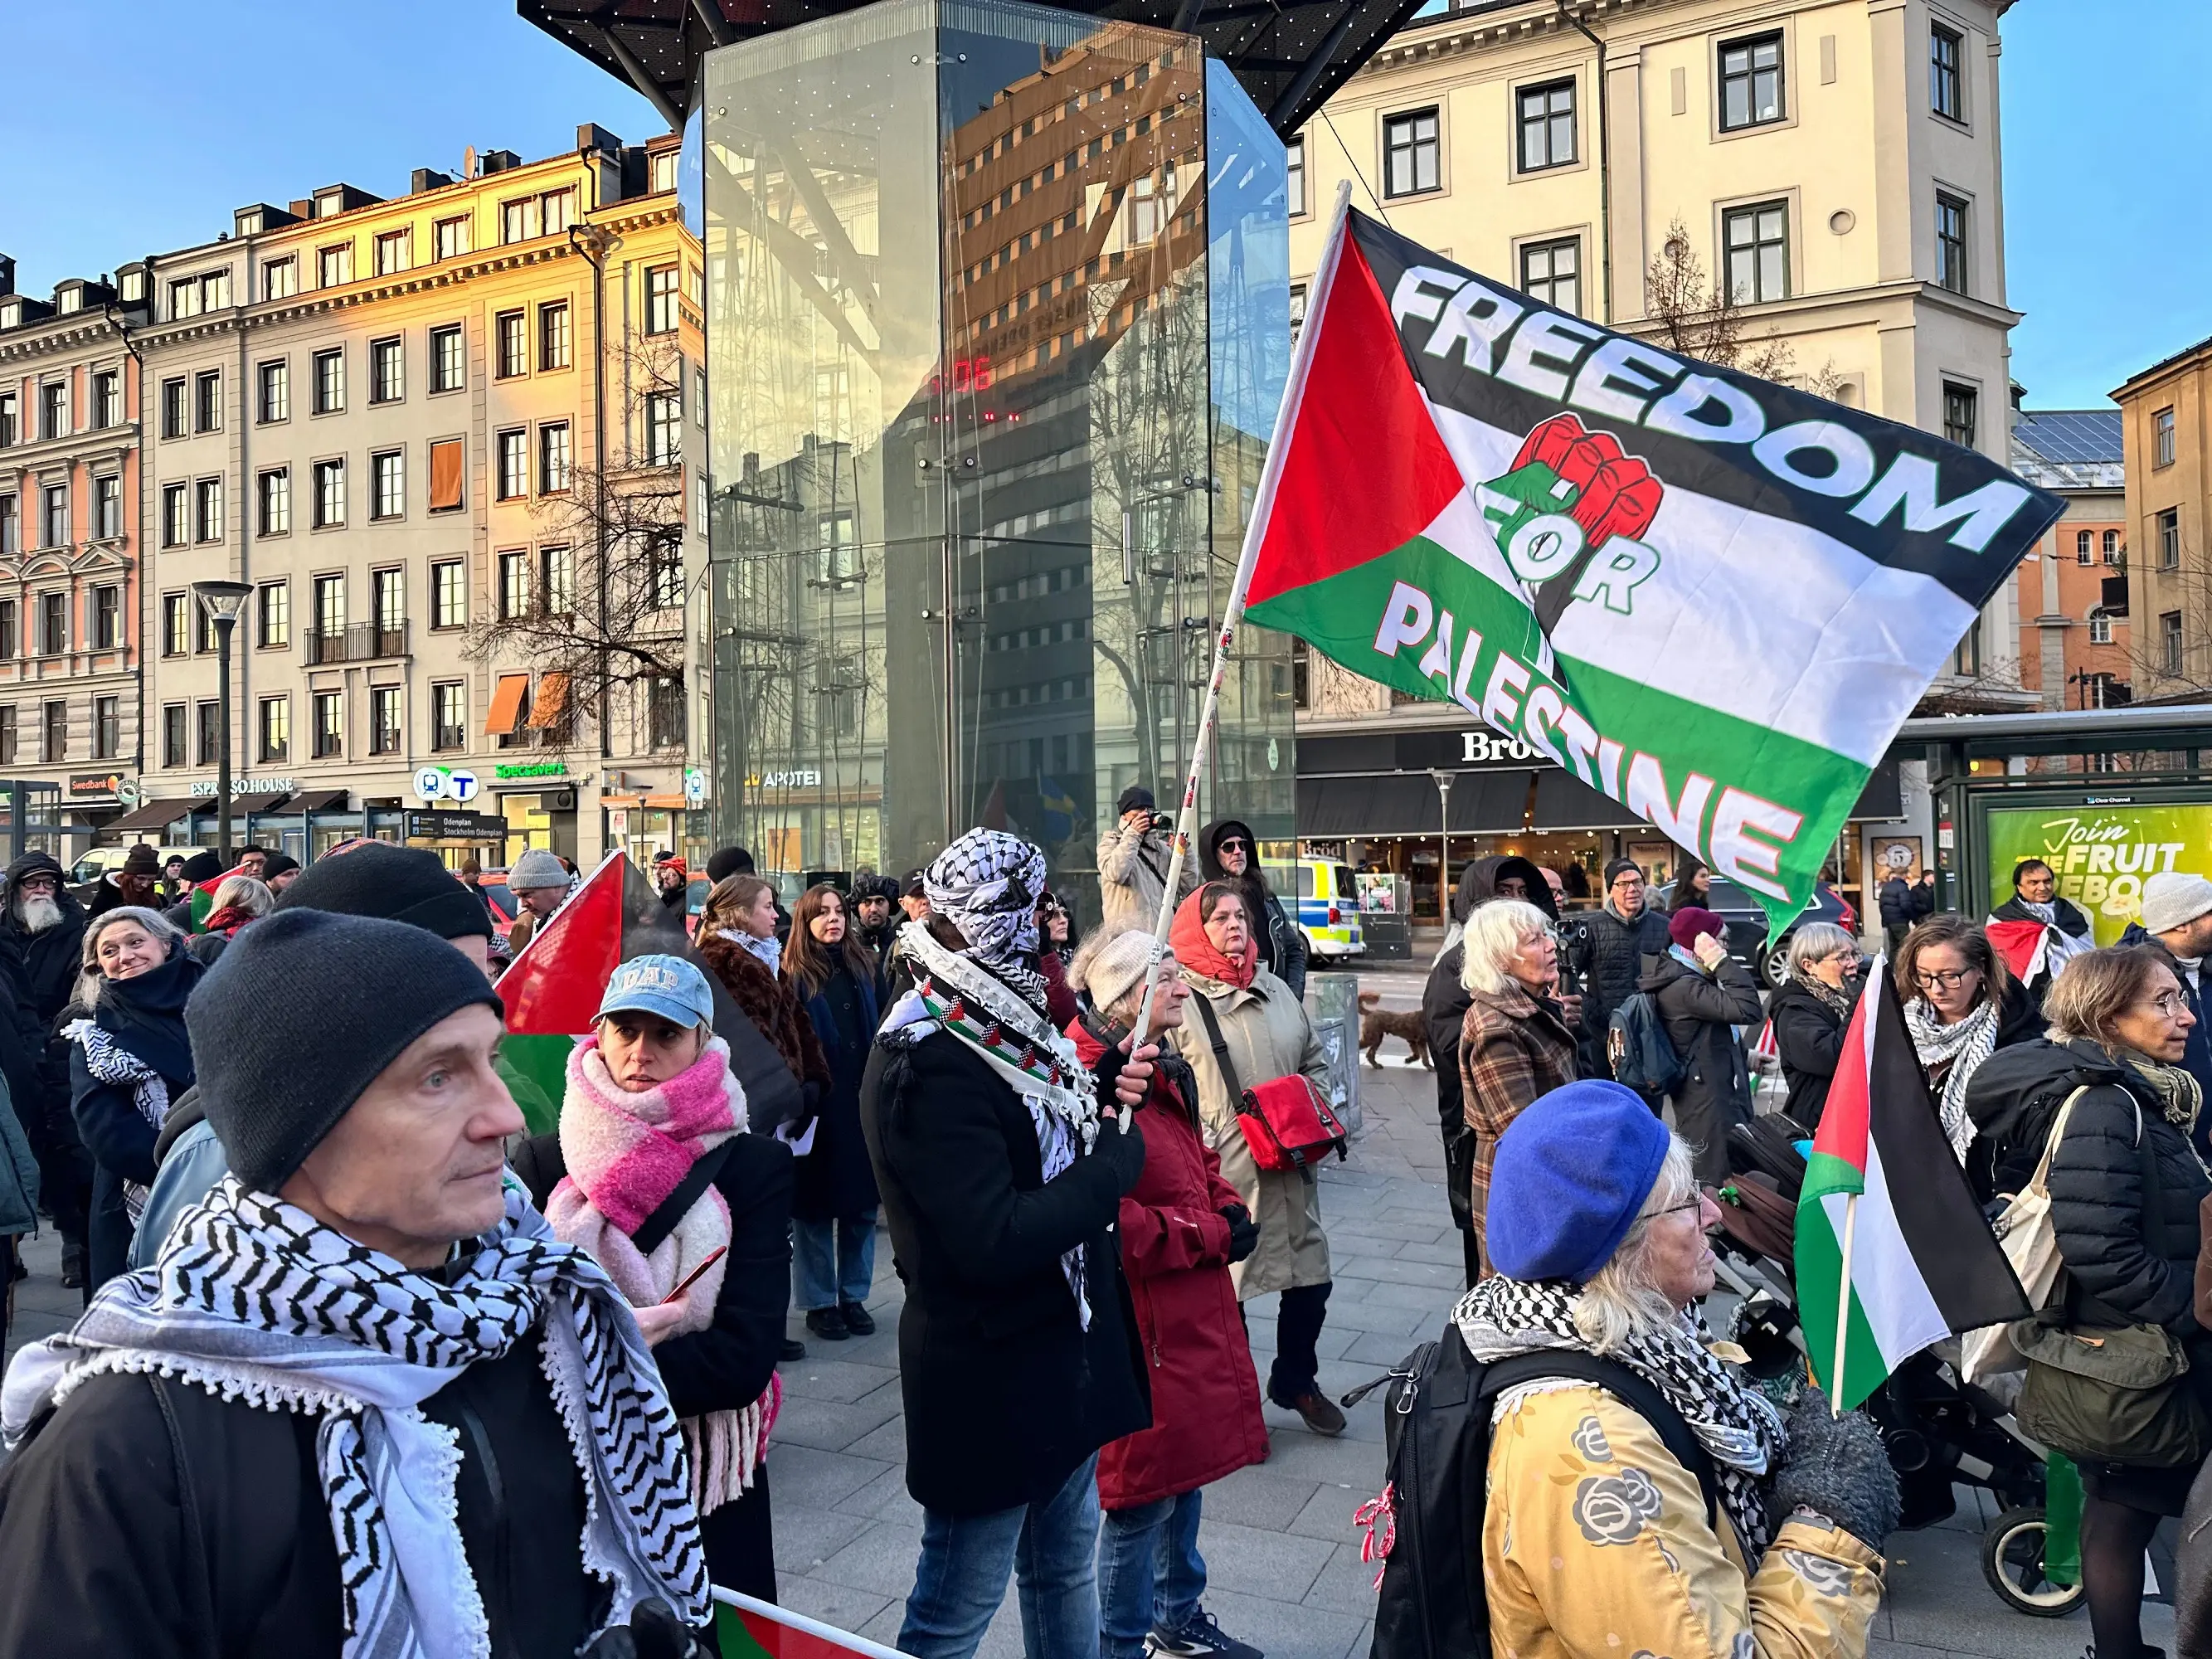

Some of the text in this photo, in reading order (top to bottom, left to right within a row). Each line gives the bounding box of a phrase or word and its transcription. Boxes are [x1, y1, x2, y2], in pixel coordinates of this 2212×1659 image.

[1391, 264, 2033, 556] FREEDOM
[1473, 481, 1661, 615] FOR
[1373, 580, 1804, 906] PALESTINE
[495, 763, 565, 779] Specsavers
[72, 780, 107, 790] Swedbank
[191, 777, 294, 796] ESPRSO HOUSE
[453, 776, 473, 797] T
[443, 817, 472, 827] Odenplan
[443, 828, 475, 836] Stockholm
[476, 829, 503, 837] Odenplan
[2041, 817, 2130, 854] Join
[2064, 843, 2185, 873] FRUIT
